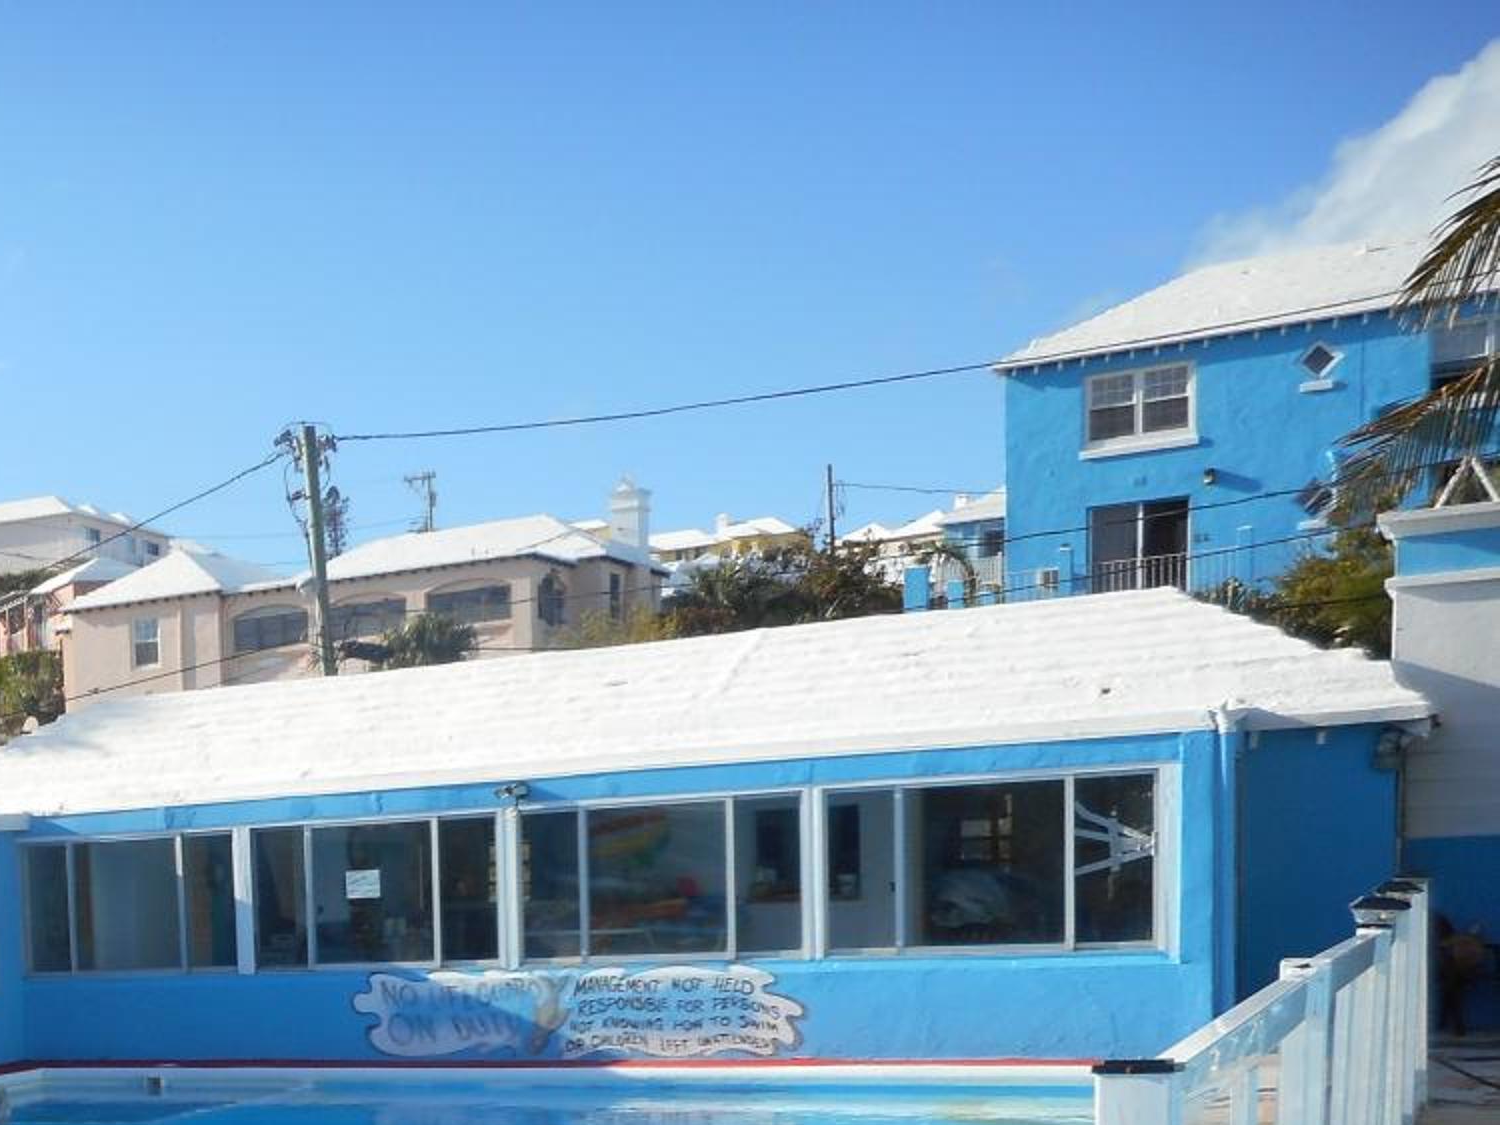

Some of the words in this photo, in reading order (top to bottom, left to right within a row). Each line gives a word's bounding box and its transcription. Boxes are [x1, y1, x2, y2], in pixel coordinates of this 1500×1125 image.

[380, 980, 419, 1008] NO
[573, 976, 661, 996] MANAGEMENT
[671, 977, 703, 993] NOT
[709, 977, 755, 995] HELD
[578, 997, 669, 1016] RESPONSIBLE
[676, 998, 704, 1013] FOR
[711, 997, 781, 1020] PERSONS
[388, 1013, 435, 1045] ON
[570, 1020, 594, 1033] NOT
[601, 1017, 663, 1031] KNOWING
[673, 1018, 703, 1031] HOW
[708, 1016, 731, 1027] TO
[739, 1016, 778, 1032] SWIM
[565, 1038, 584, 1052] OR
[591, 1033, 647, 1049] CHILDREN
[660, 1038, 690, 1052] LEFT
